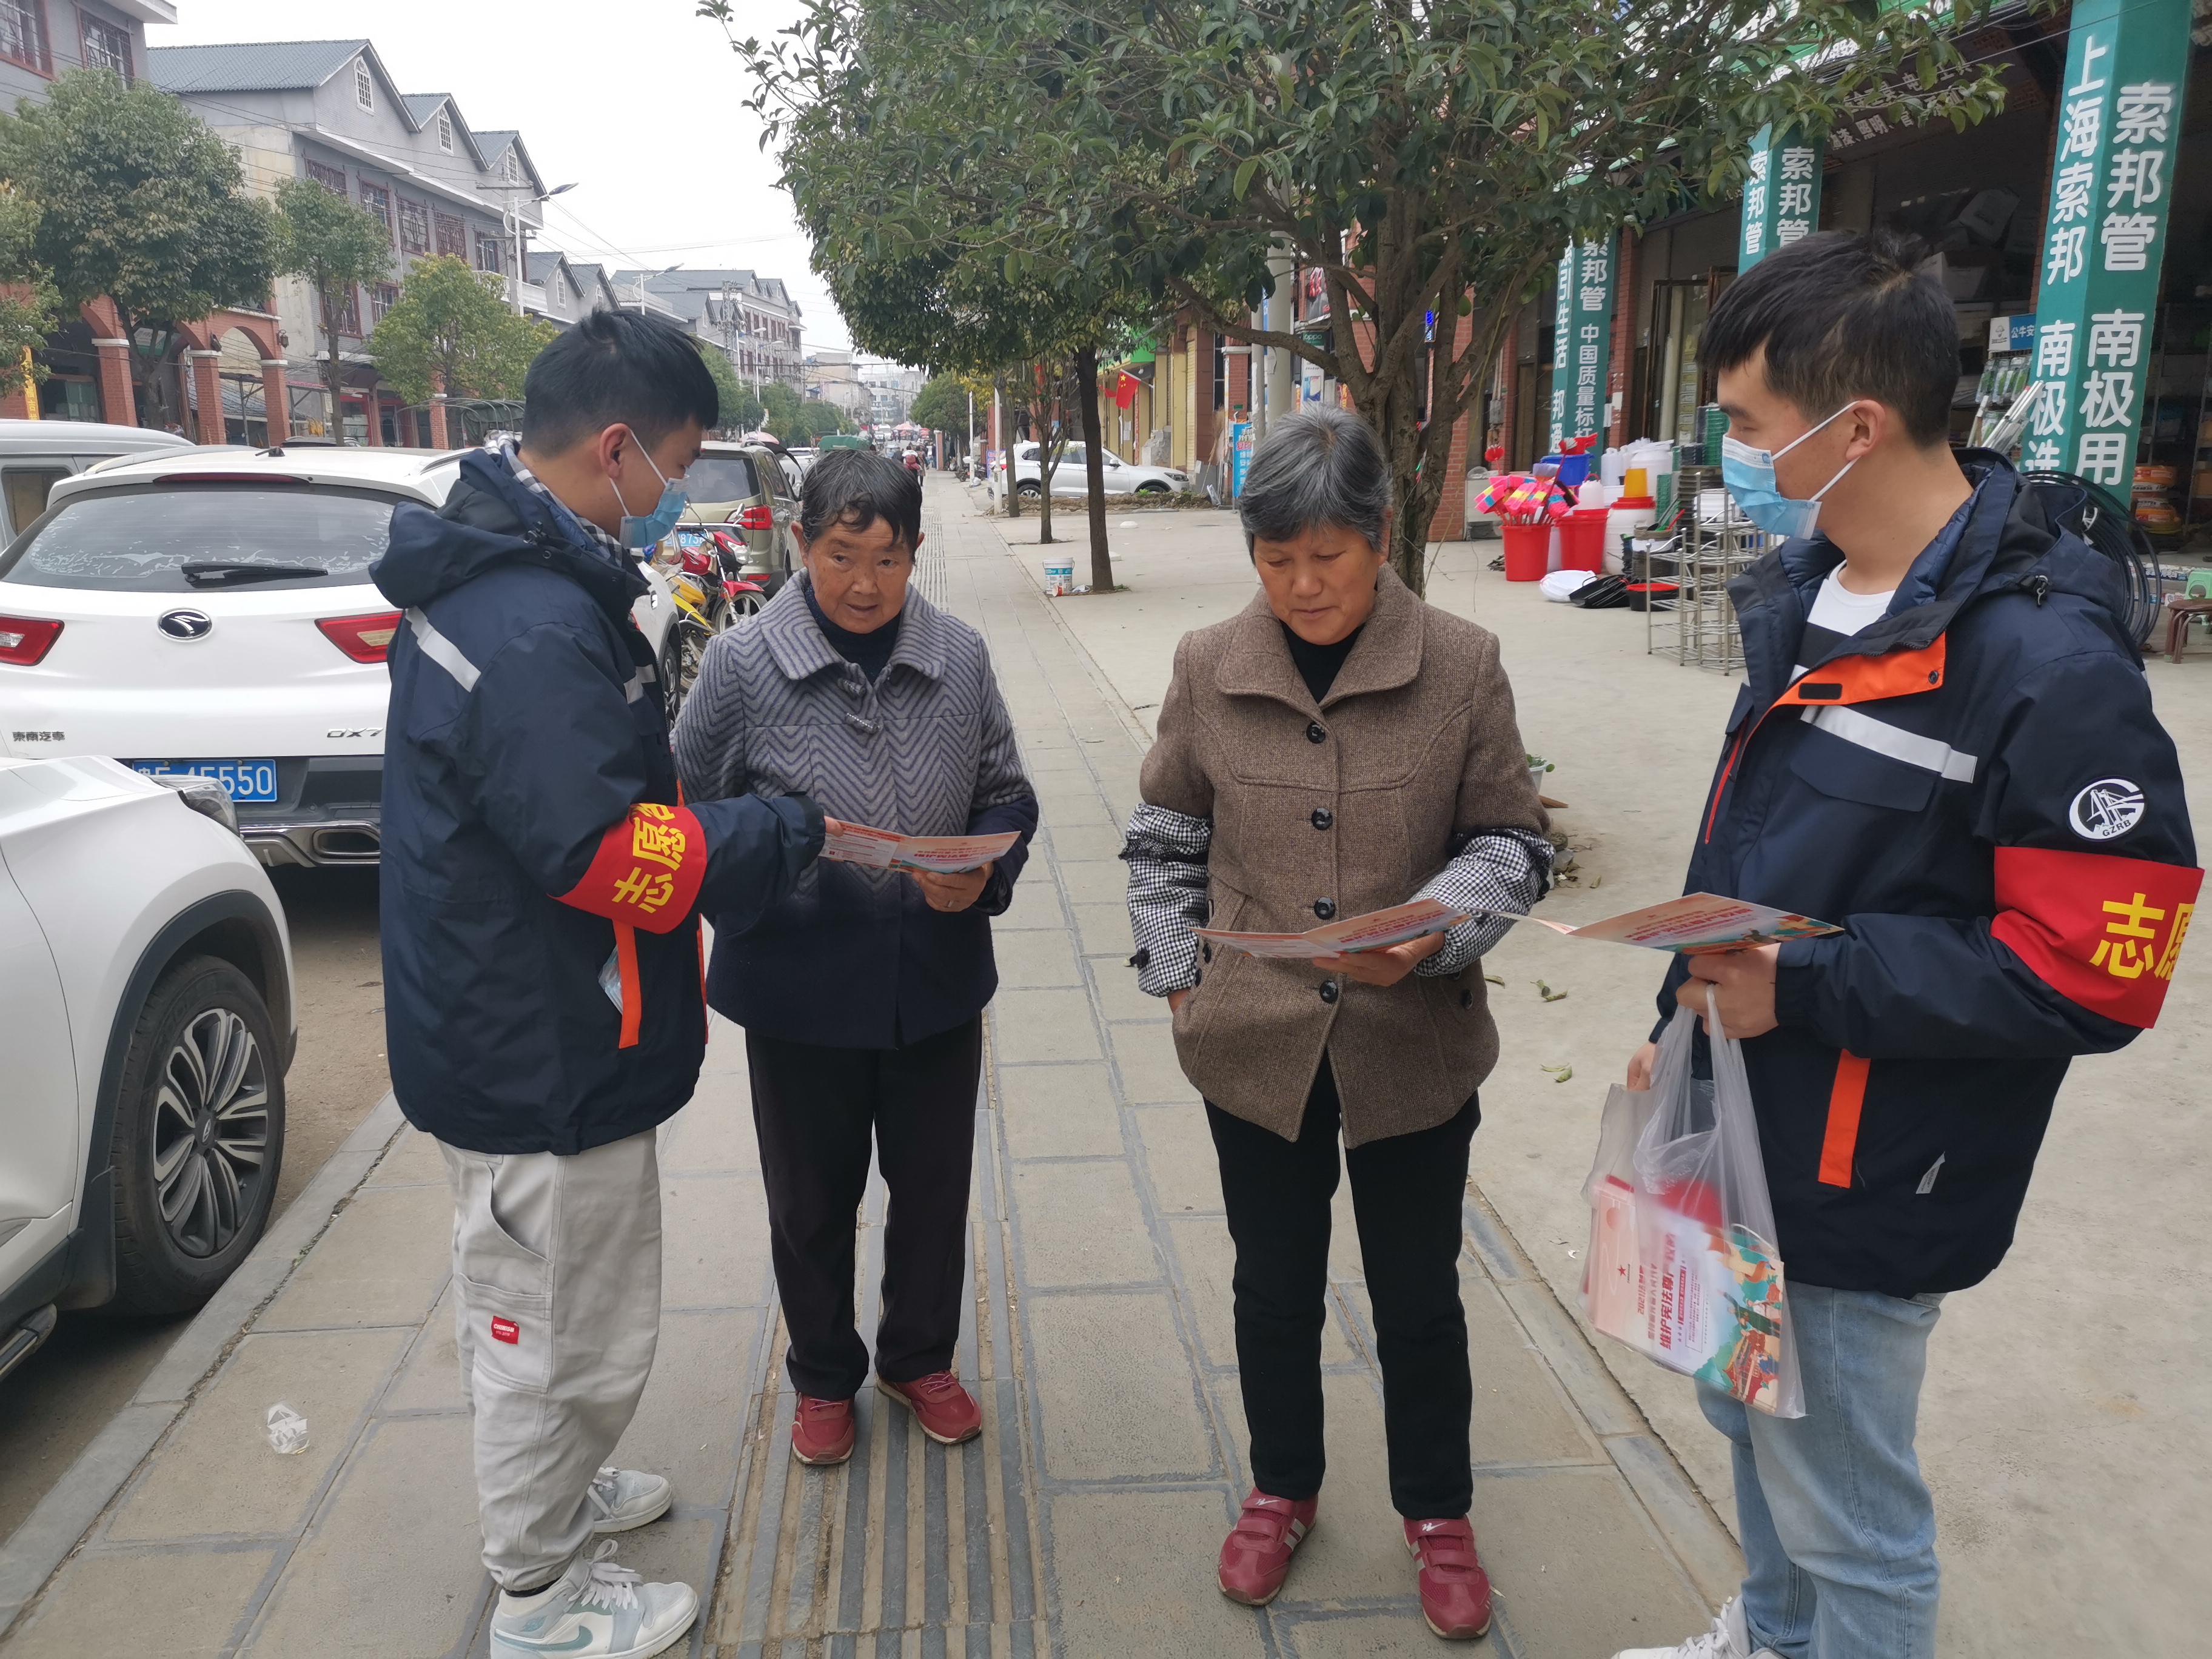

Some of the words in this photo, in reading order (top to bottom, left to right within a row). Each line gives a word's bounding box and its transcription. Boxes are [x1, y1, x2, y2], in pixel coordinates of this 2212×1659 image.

[1745, 150, 1768, 255] 索邦管
[1776, 146, 1815, 249] 索邦管
[2047, 35, 2110, 286] 上海索邦
[2100, 80, 2173, 271] 索邦管
[2011, 325, 2035, 339] 公牛安
[1550, 389, 1565, 454] 邦通
[2074, 308, 2145, 485] 南极用
[2102, 819, 2131, 836] GZRB
